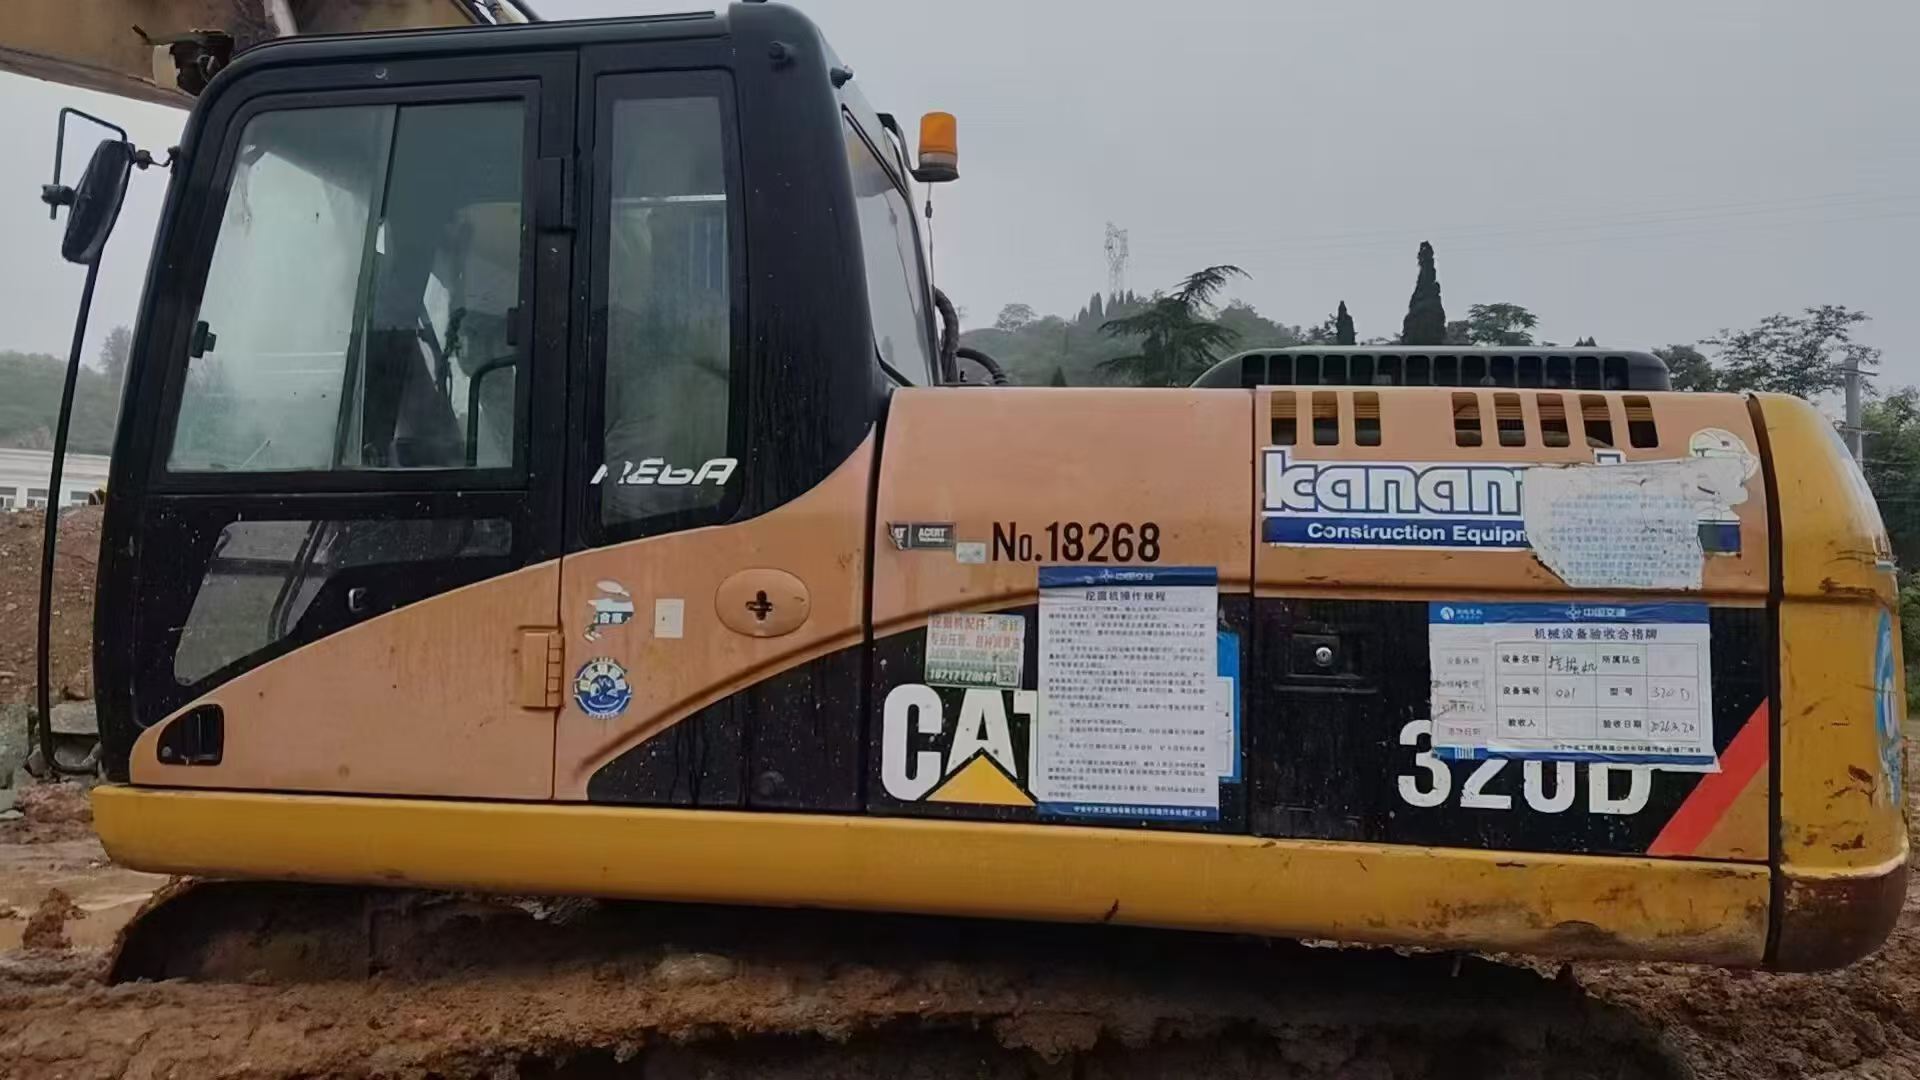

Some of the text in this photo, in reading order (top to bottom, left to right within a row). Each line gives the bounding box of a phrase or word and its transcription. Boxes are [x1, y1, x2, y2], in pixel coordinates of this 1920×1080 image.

[1307, 523, 1446, 542] Construction
[992, 521, 1160, 562] No.18268
[1534, 627, 1658, 641] 机械设备验收合格牌
[1502, 654, 1540, 664] 设备名称
[1602, 655, 1641, 664] 所属队伍
[1503, 686, 1540, 695] 设备编号
[1508, 717, 1536, 728] 验收人
[1603, 719, 1642, 729] 验收日期
